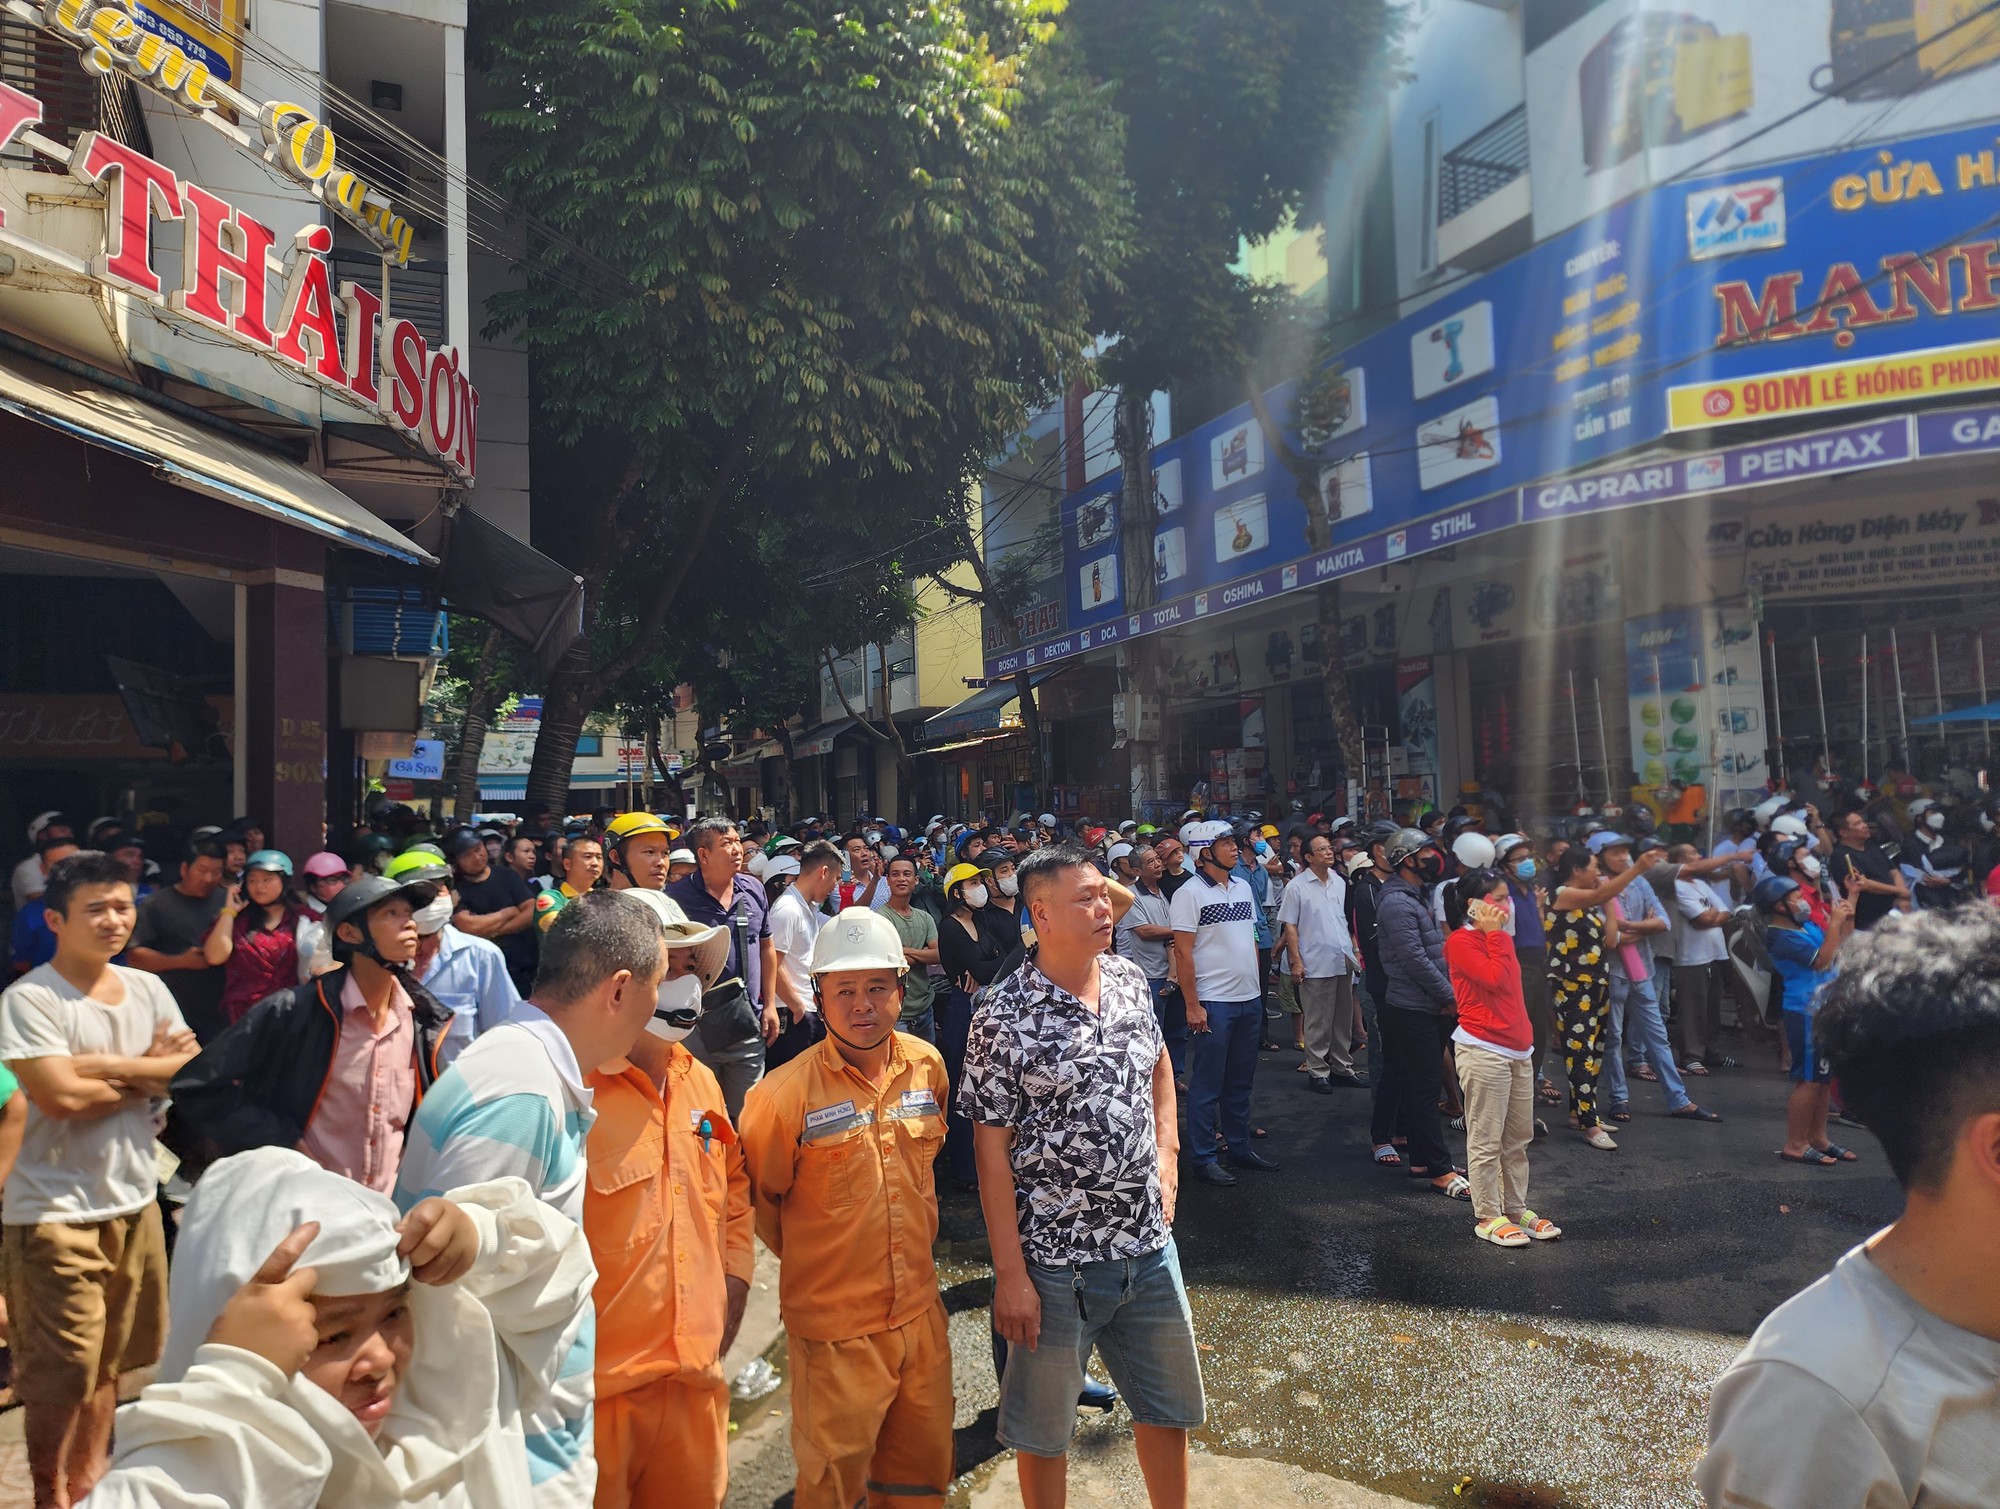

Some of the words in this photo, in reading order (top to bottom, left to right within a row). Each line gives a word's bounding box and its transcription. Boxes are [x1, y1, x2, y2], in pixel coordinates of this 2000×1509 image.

[1831, 150, 1943, 210] CỬA
[1957, 137, 2000, 190] H
[78, 131, 382, 407] THÁI
[386, 319, 480, 481] SƠN
[1743, 374, 1814, 414] 90M
[1822, 373, 1849, 401] LÊ
[1609, 405, 1632, 430] TAY
[1740, 431, 1884, 478] PENTAX
[1537, 466, 1674, 510] CAPRARI
[1431, 512, 1477, 541] STIHL
[1316, 548, 1364, 577] MAKITA
[1223, 580, 1264, 605] OSHIMA
[1153, 605, 1181, 626] TOTAL
[1101, 625, 1118, 641] DCA
[1044, 640, 1071, 658] DEKTON
[998, 656, 1018, 672] BOSCH
[415, 762, 438, 775] Spa
